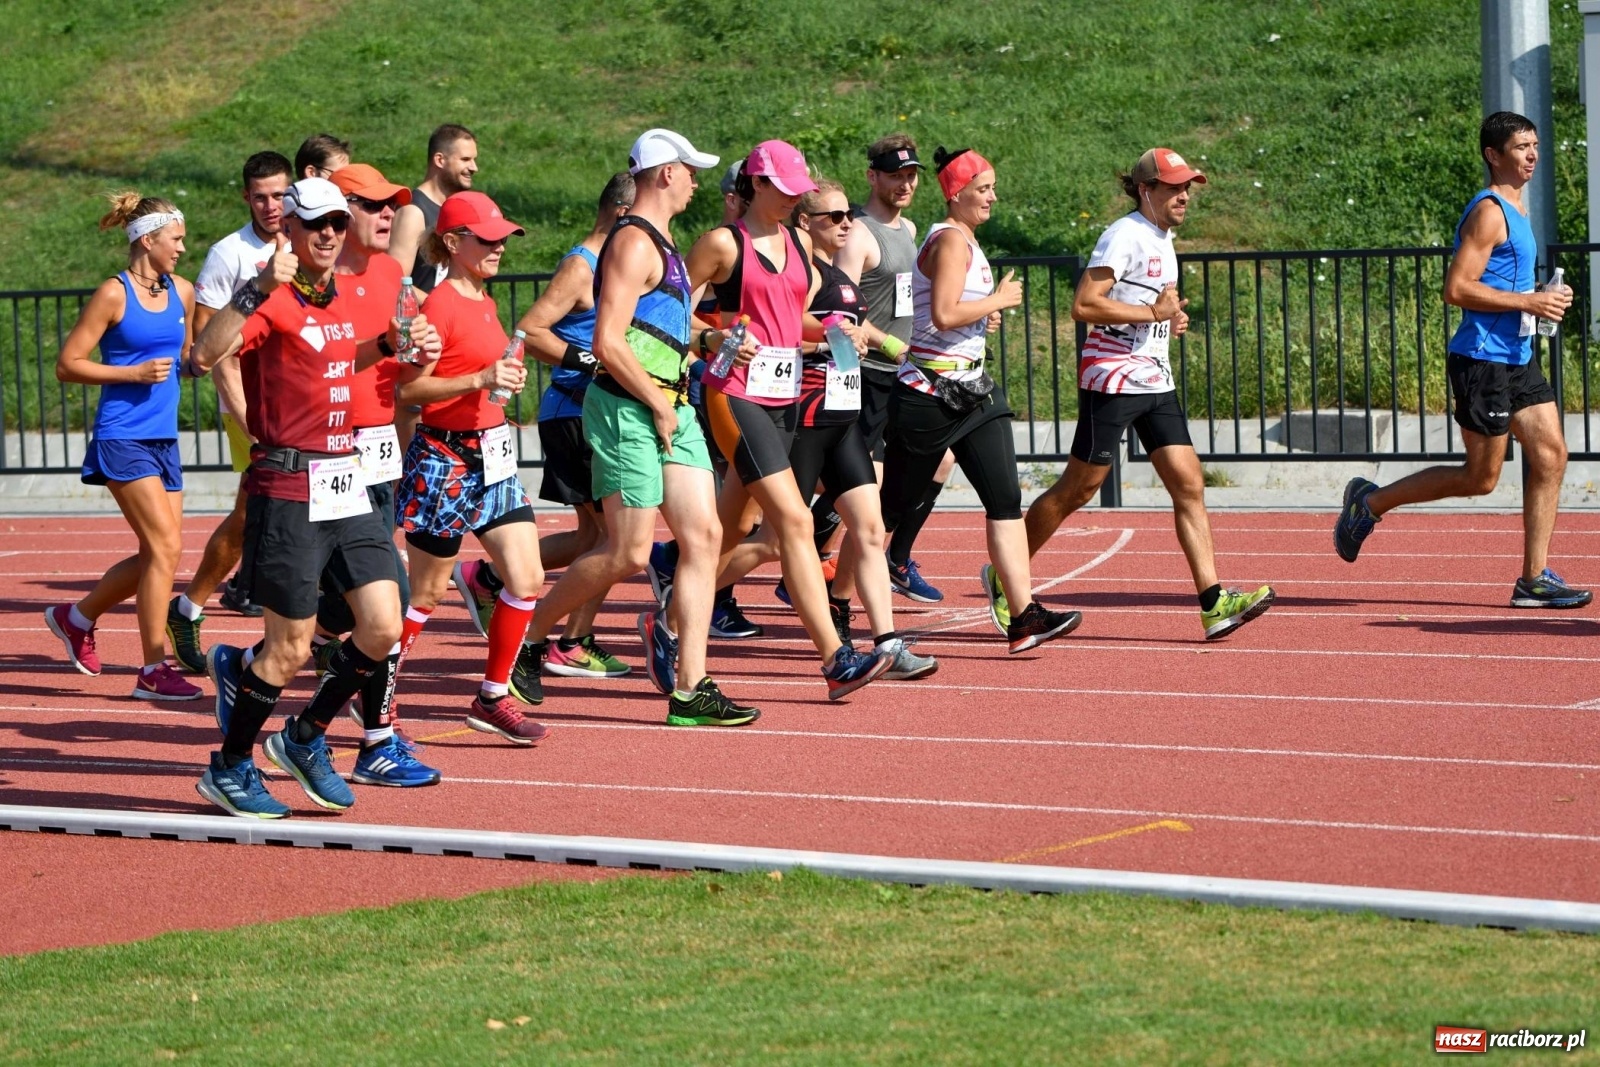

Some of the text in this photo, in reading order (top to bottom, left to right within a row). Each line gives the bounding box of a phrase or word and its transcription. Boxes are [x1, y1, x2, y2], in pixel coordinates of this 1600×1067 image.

[774, 361, 792, 379] 64
[843, 374, 860, 390] 400
[329, 385, 350, 403] RUN
[328, 411, 346, 427] FIT
[379, 441, 393, 460] 53
[330, 473, 353, 494] 467
